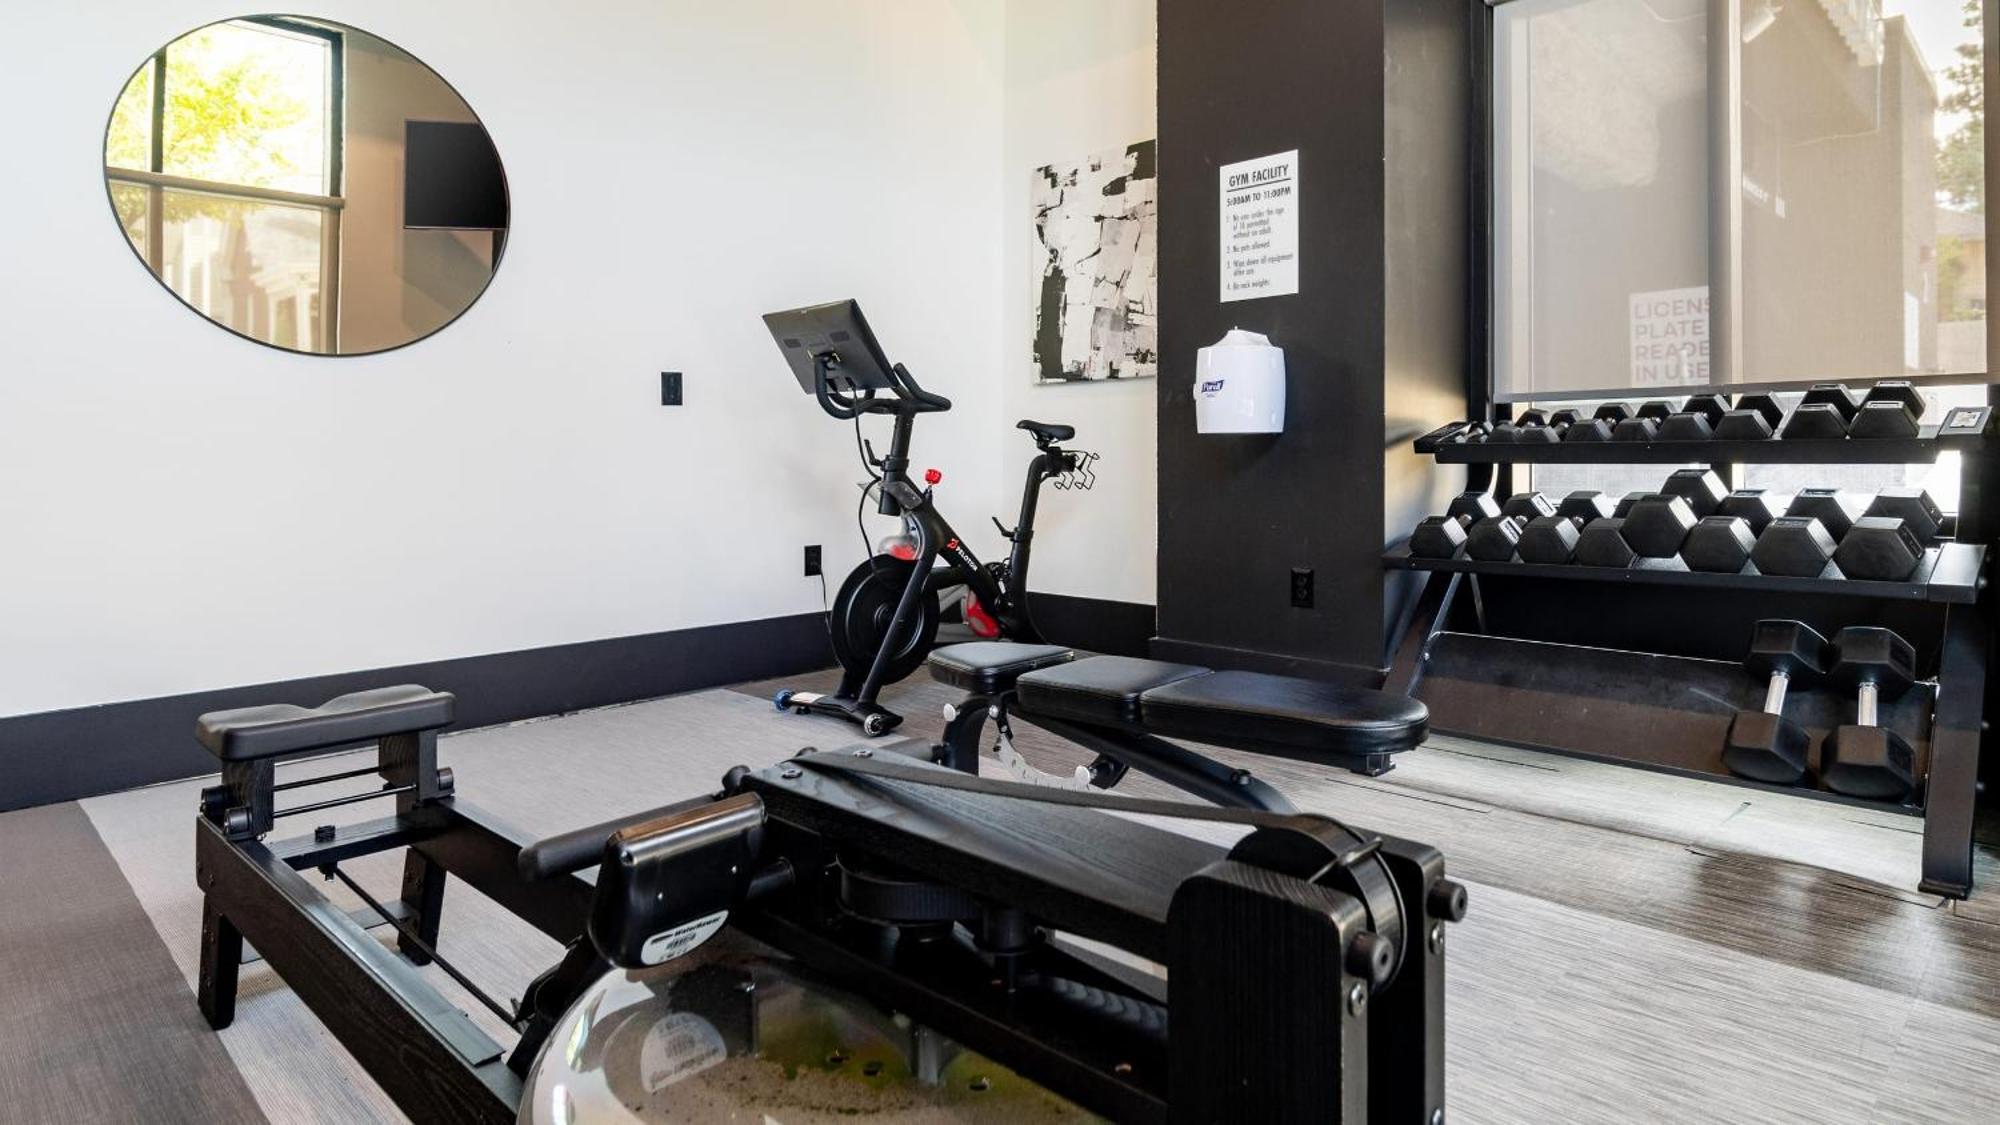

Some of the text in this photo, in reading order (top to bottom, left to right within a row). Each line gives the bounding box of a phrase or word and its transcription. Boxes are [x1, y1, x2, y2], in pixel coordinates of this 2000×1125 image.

[1228, 163, 1289, 187] GYM FACILITY
[1226, 186, 1291, 207] 5:00AM TO 11:00PM
[1634, 319, 1705, 340] PLATE
[1634, 364, 1658, 382] IN
